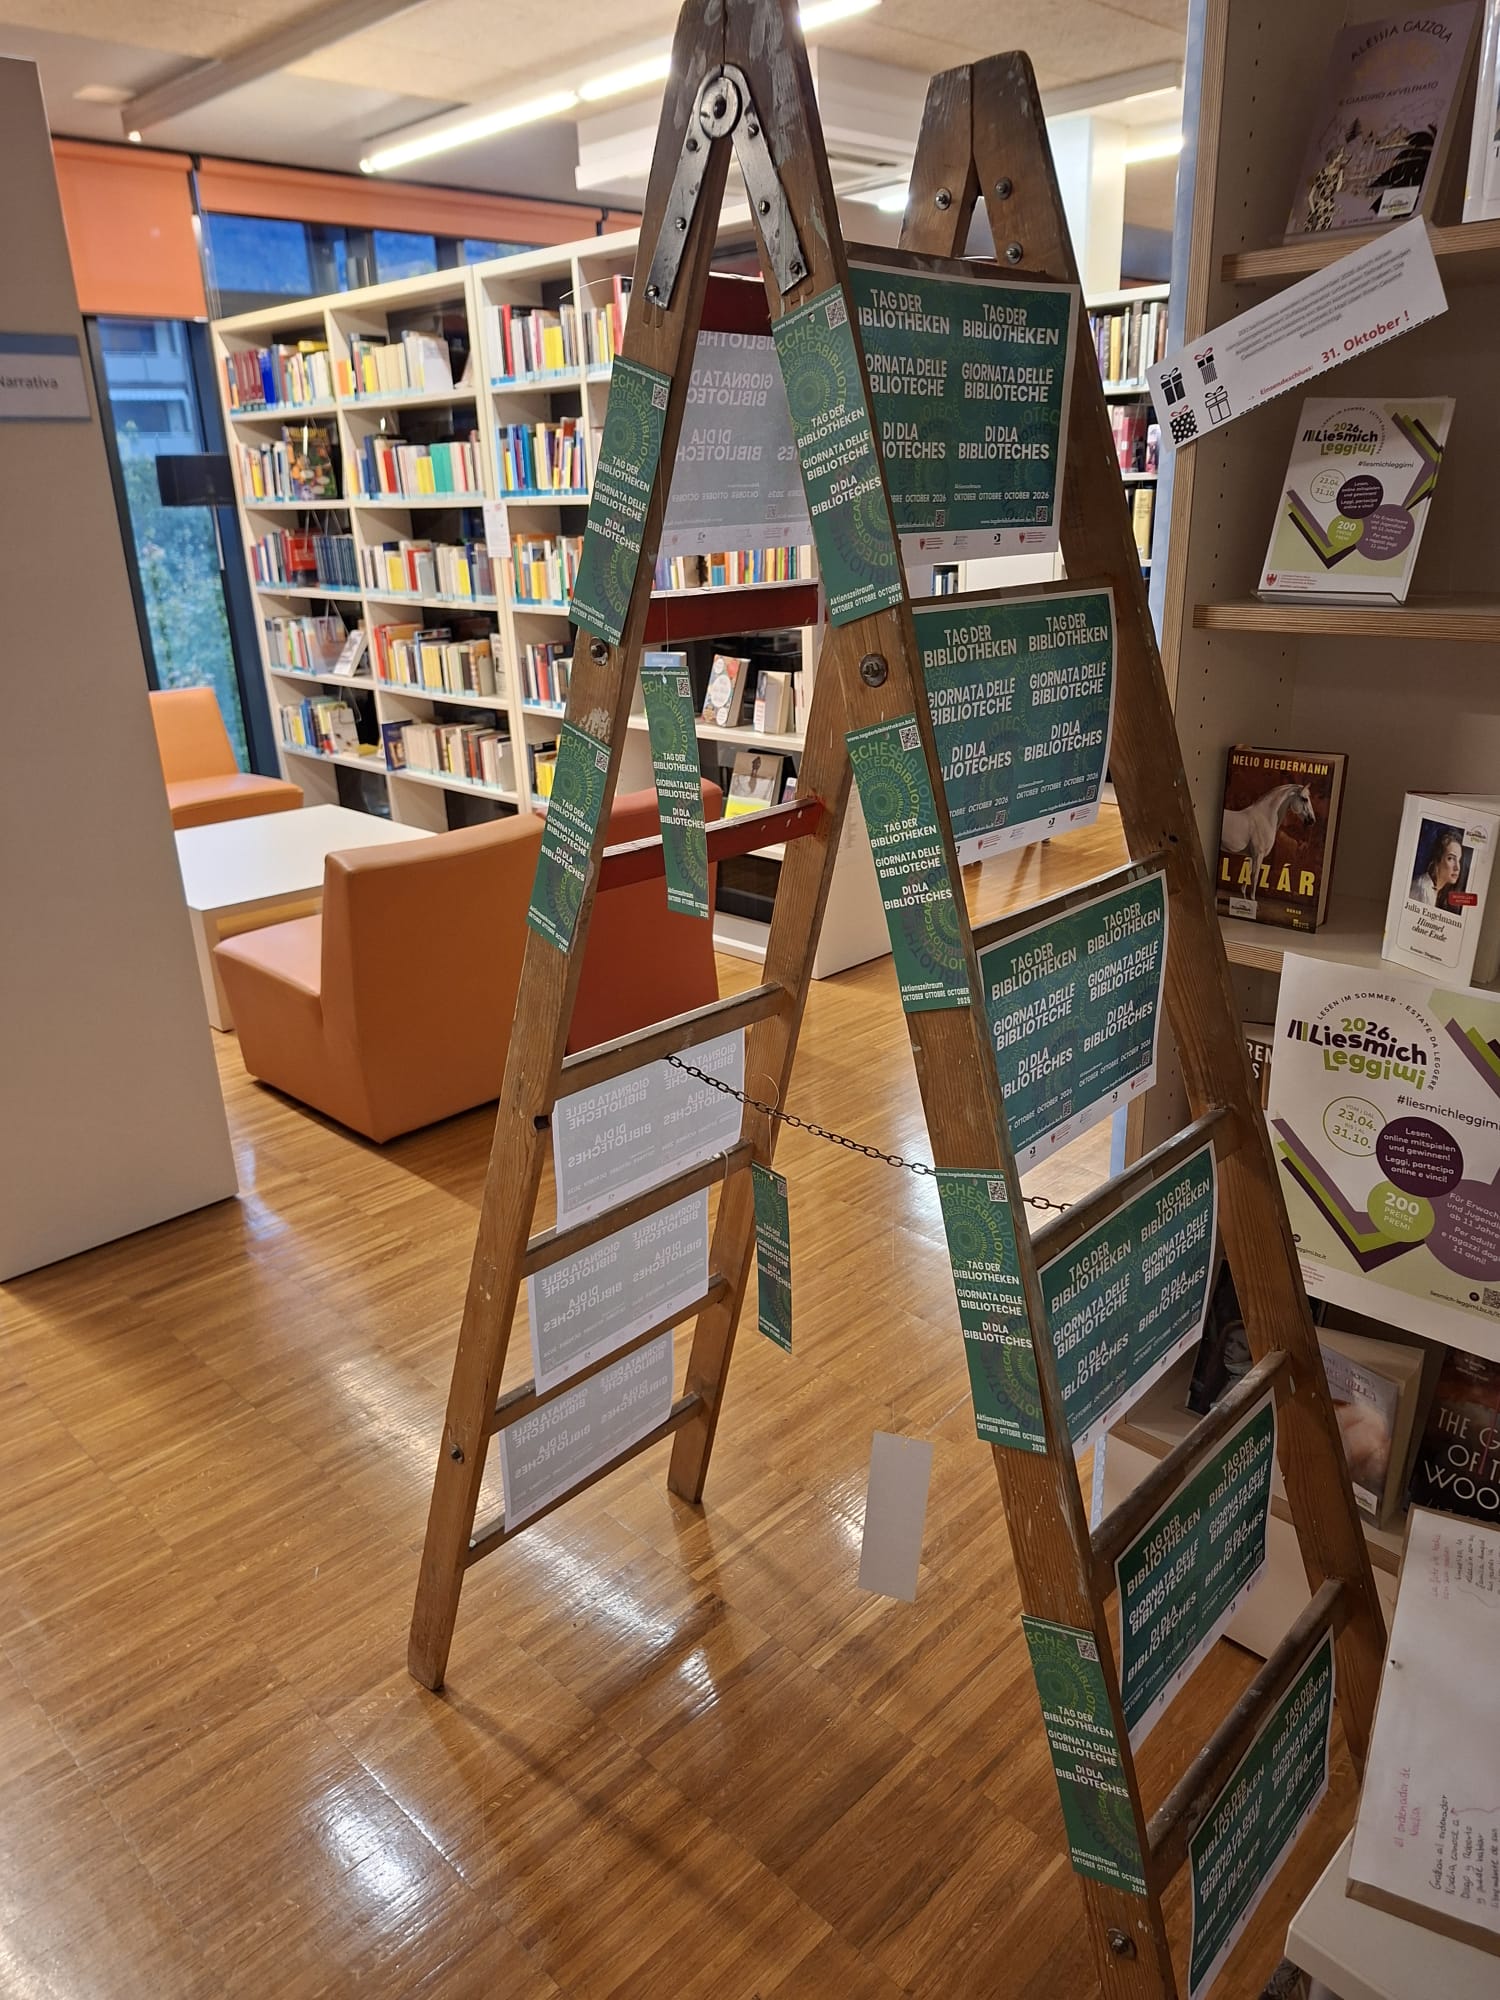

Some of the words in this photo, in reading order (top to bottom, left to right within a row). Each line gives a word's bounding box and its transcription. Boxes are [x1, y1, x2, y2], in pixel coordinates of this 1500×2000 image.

[1403, 20, 1453, 43] GAZZOLA
[870, 289, 897, 310] TAG
[899, 293, 922, 313] DER
[858, 306, 949, 335] IBLIOTHEKEN
[983, 304, 1004, 323] TAG
[1004, 306, 1028, 326] DER
[963, 321, 1059, 345] BIBLIOTHEKEN
[1321, 348, 1341, 364] 31.
[1344, 318, 1401, 352] Oktober
[865, 354, 915, 375] ORNATA
[917, 358, 947, 378] DELLE
[961, 363, 1016, 384] GIORNATA
[1017, 367, 1053, 385] DELLE
[870, 375, 944, 397] BLIOTECHE
[964, 382, 1048, 402] BIBLIOTECHE
[798, 407, 865, 448] BIBLIOTHEKEN
[811, 412, 829, 428] TAG
[829, 404, 845, 419] DER
[1334, 423, 1359, 432] 2026
[985, 426, 996, 441] DI
[998, 426, 1017, 442] DLA
[1315, 431, 1378, 443] Liesmich
[802, 444, 845, 469] GIORNATA
[846, 430, 869, 451] DELLE
[958, 443, 1049, 460] BIBLIOTECHES
[612, 456, 626, 470] TAG
[625, 461, 639, 475] DER
[807, 444, 869, 481] BIBLIOTECHE
[597, 462, 649, 493] BIBLIOTHEKEN
[594, 492, 642, 522] BIBLIOTECHE
[811, 477, 882, 516] BIBLIOTECHES
[1004, 492, 1030, 500] OCTOBER
[1033, 491, 1049, 499] 2026
[587, 519, 640, 553] BIBLIOTECHES
[1337, 521, 1356, 530] 200
[830, 583, 874, 606] Aktionszeitraum
[831, 601, 854, 615] OKTOBER
[855, 592, 877, 607] OTTOBRE
[878, 583, 901, 597] OCTOBER
[1046, 616, 1066, 632] TAG
[1068, 613, 1086, 629] DER
[944, 628, 968, 646] TAG
[970, 625, 992, 643] DER
[1029, 626, 1108, 652] BIBLIOTHEKEN
[924, 639, 1017, 668] BIBLIOTHEKEN
[1030, 667, 1080, 690] GIORNATA
[1081, 662, 1106, 680] DELLE
[928, 682, 985, 707] GIORNATA
[986, 678, 1015, 699] DELLE
[1032, 678, 1103, 707] BIBLIOTECHE
[1024, 730, 1102, 762] BIBLIOTECHES
[654, 761, 698, 773] BIBLIOTHEKEN
[1232, 755, 1260, 767] NELIO
[1264, 758, 1328, 775] BIEDERMANN
[549, 800, 593, 835] BIBLIOTHEKEN
[561, 798, 574, 811] TAG
[573, 806, 584, 820] DER
[871, 825, 937, 848] BIBLIOTHEKEN
[884, 822, 903, 833] TAG
[902, 818, 918, 830] DER
[876, 851, 917, 867] GIORNATA
[918, 845, 941, 859] DELLE
[880, 858, 941, 879] BIBLIOTECHE
[1221, 856, 1315, 896] LÁZÁR
[884, 889, 952, 910] BIBLIOTECHES
[1103, 912, 1123, 932] TAG
[1123, 903, 1140, 923] DER
[1404, 901, 1420, 915] Julia
[1422, 908, 1462, 929] Engelmann
[1417, 917, 1445, 933] Himmel
[1088, 908, 1161, 955] BIBLIOTHEKEN
[1412, 925, 1429, 937] ohne
[1429, 930, 1447, 942] Ende
[1088, 953, 1134, 988] GIORNATA
[1135, 940, 1158, 962] DELLE
[1090, 957, 1155, 1002] BIBLIOTECHE
[1317, 1000, 1339, 1020] LESEN
[1341, 995, 1351, 1003] IM
[1354, 992, 1397, 1003] SOMMER
[1084, 1001, 1153, 1053] BIBLIOTECHES
[1341, 1017, 1390, 1041] 2026
[1405, 1005, 1432, 1034] ESTATE
[1309, 1026, 1427, 1066] Liesmich
[1430, 1036, 1438, 1048] DA
[1428, 1051, 1441, 1091] LEGGERE
[1337, 1108, 1376, 1132] 23.04.
[1332, 1125, 1371, 1149] 31.10.
[1384, 1133, 1408, 1144] online
[1411, 1138, 1456, 1153] mitspielen
[1406, 1127, 1433, 1139] Lesen,
[1389, 1144, 1405, 1153] und
[1407, 1146, 1451, 1161] gewinnen!
[1385, 1155, 1411, 1167] Leggi,
[1412, 1160, 1454, 1175] partecipa
[1391, 1165, 1416, 1177] online
[1426, 1173, 1447, 1183] vinci!
[1384, 1192, 1420, 1215] 200
[1384, 1206, 1414, 1224] PREISE
[1447, 1202, 1463, 1213] und
[1450, 1192, 1464, 1204] Für
[1466, 1200, 1500, 1220] Erwach
[1383, 1215, 1411, 1231] PREMI
[1450, 1213, 1460, 1221] ab
[1463, 1218, 1473, 1227] 11
[1475, 1224, 1500, 1238] Jahre
[1448, 1235, 1480, 1253] ragazzi
[1452, 1245, 1463, 1254] 11
[1454, 1226, 1469, 1237] Per
[1471, 1235, 1496, 1250] adulti
[967, 1261, 984, 1270] TAG
[985, 1263, 1000, 1272] DER
[1069, 1256, 1090, 1283] TAG
[1088, 1241, 1110, 1265] DER
[954, 1269, 1020, 1285] BIBLIOTHEKEN
[1052, 1240, 1131, 1313] BIBLIOTHEKEN
[1057, 1288, 1128, 1359] BIBLIOTECHE
[1061, 1333, 1129, 1401] IBLIOTECHES
[1438, 1407, 1471, 1439] THE
[1448, 1444, 1480, 1472] OF
[1424, 1460, 1500, 1510] WOO
[1127, 1507, 1200, 1598] BIBLIOTHEKEN
[1043, 1711, 1114, 1740] BIBLIOTHEKEN
[1057, 1705, 1076, 1720] TAG
[1076, 1710, 1094, 1724] DER
[1056, 1768, 1129, 1799] BIBLIOTECHES
[1395, 1783, 1409, 1832] ordenador
